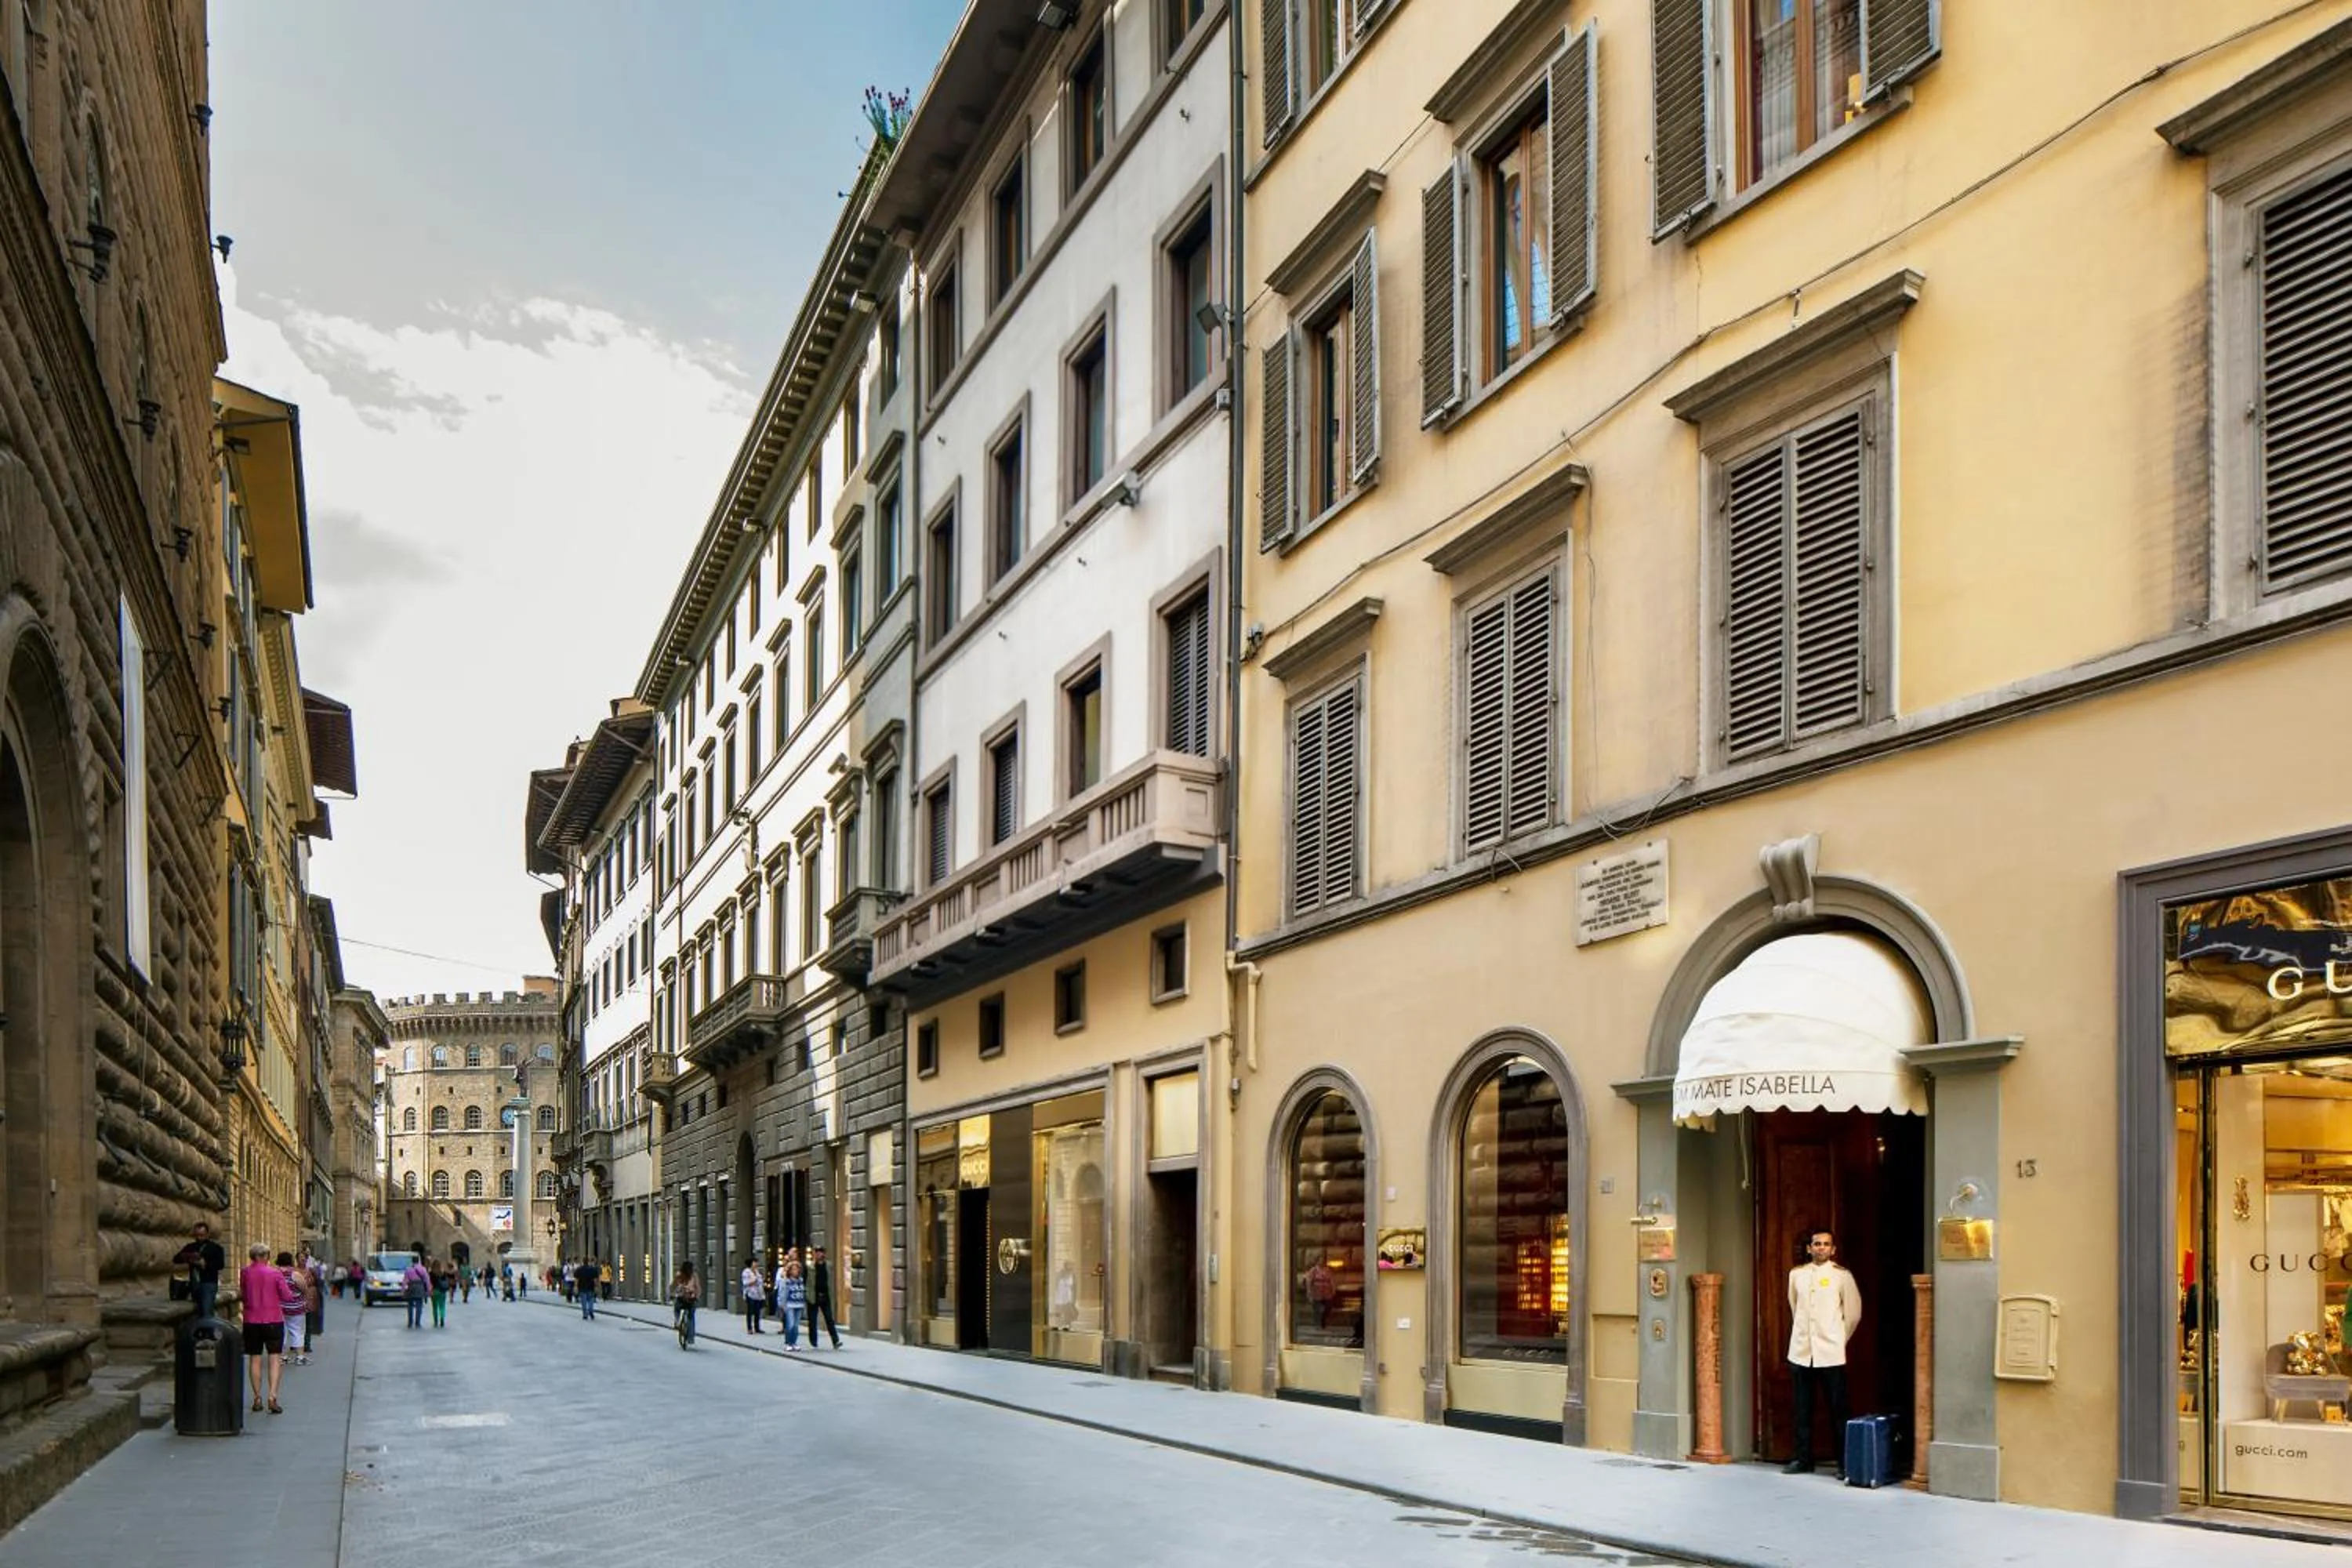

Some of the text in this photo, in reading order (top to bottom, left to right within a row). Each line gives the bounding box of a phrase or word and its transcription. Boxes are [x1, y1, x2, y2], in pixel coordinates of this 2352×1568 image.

[1691, 1078, 1733, 1099] MATE
[1740, 1075, 1836, 1096] ISABELLA
[2249, 1252, 2352, 1272] GUCC
[2235, 1444, 2308, 1459] gucci.com
